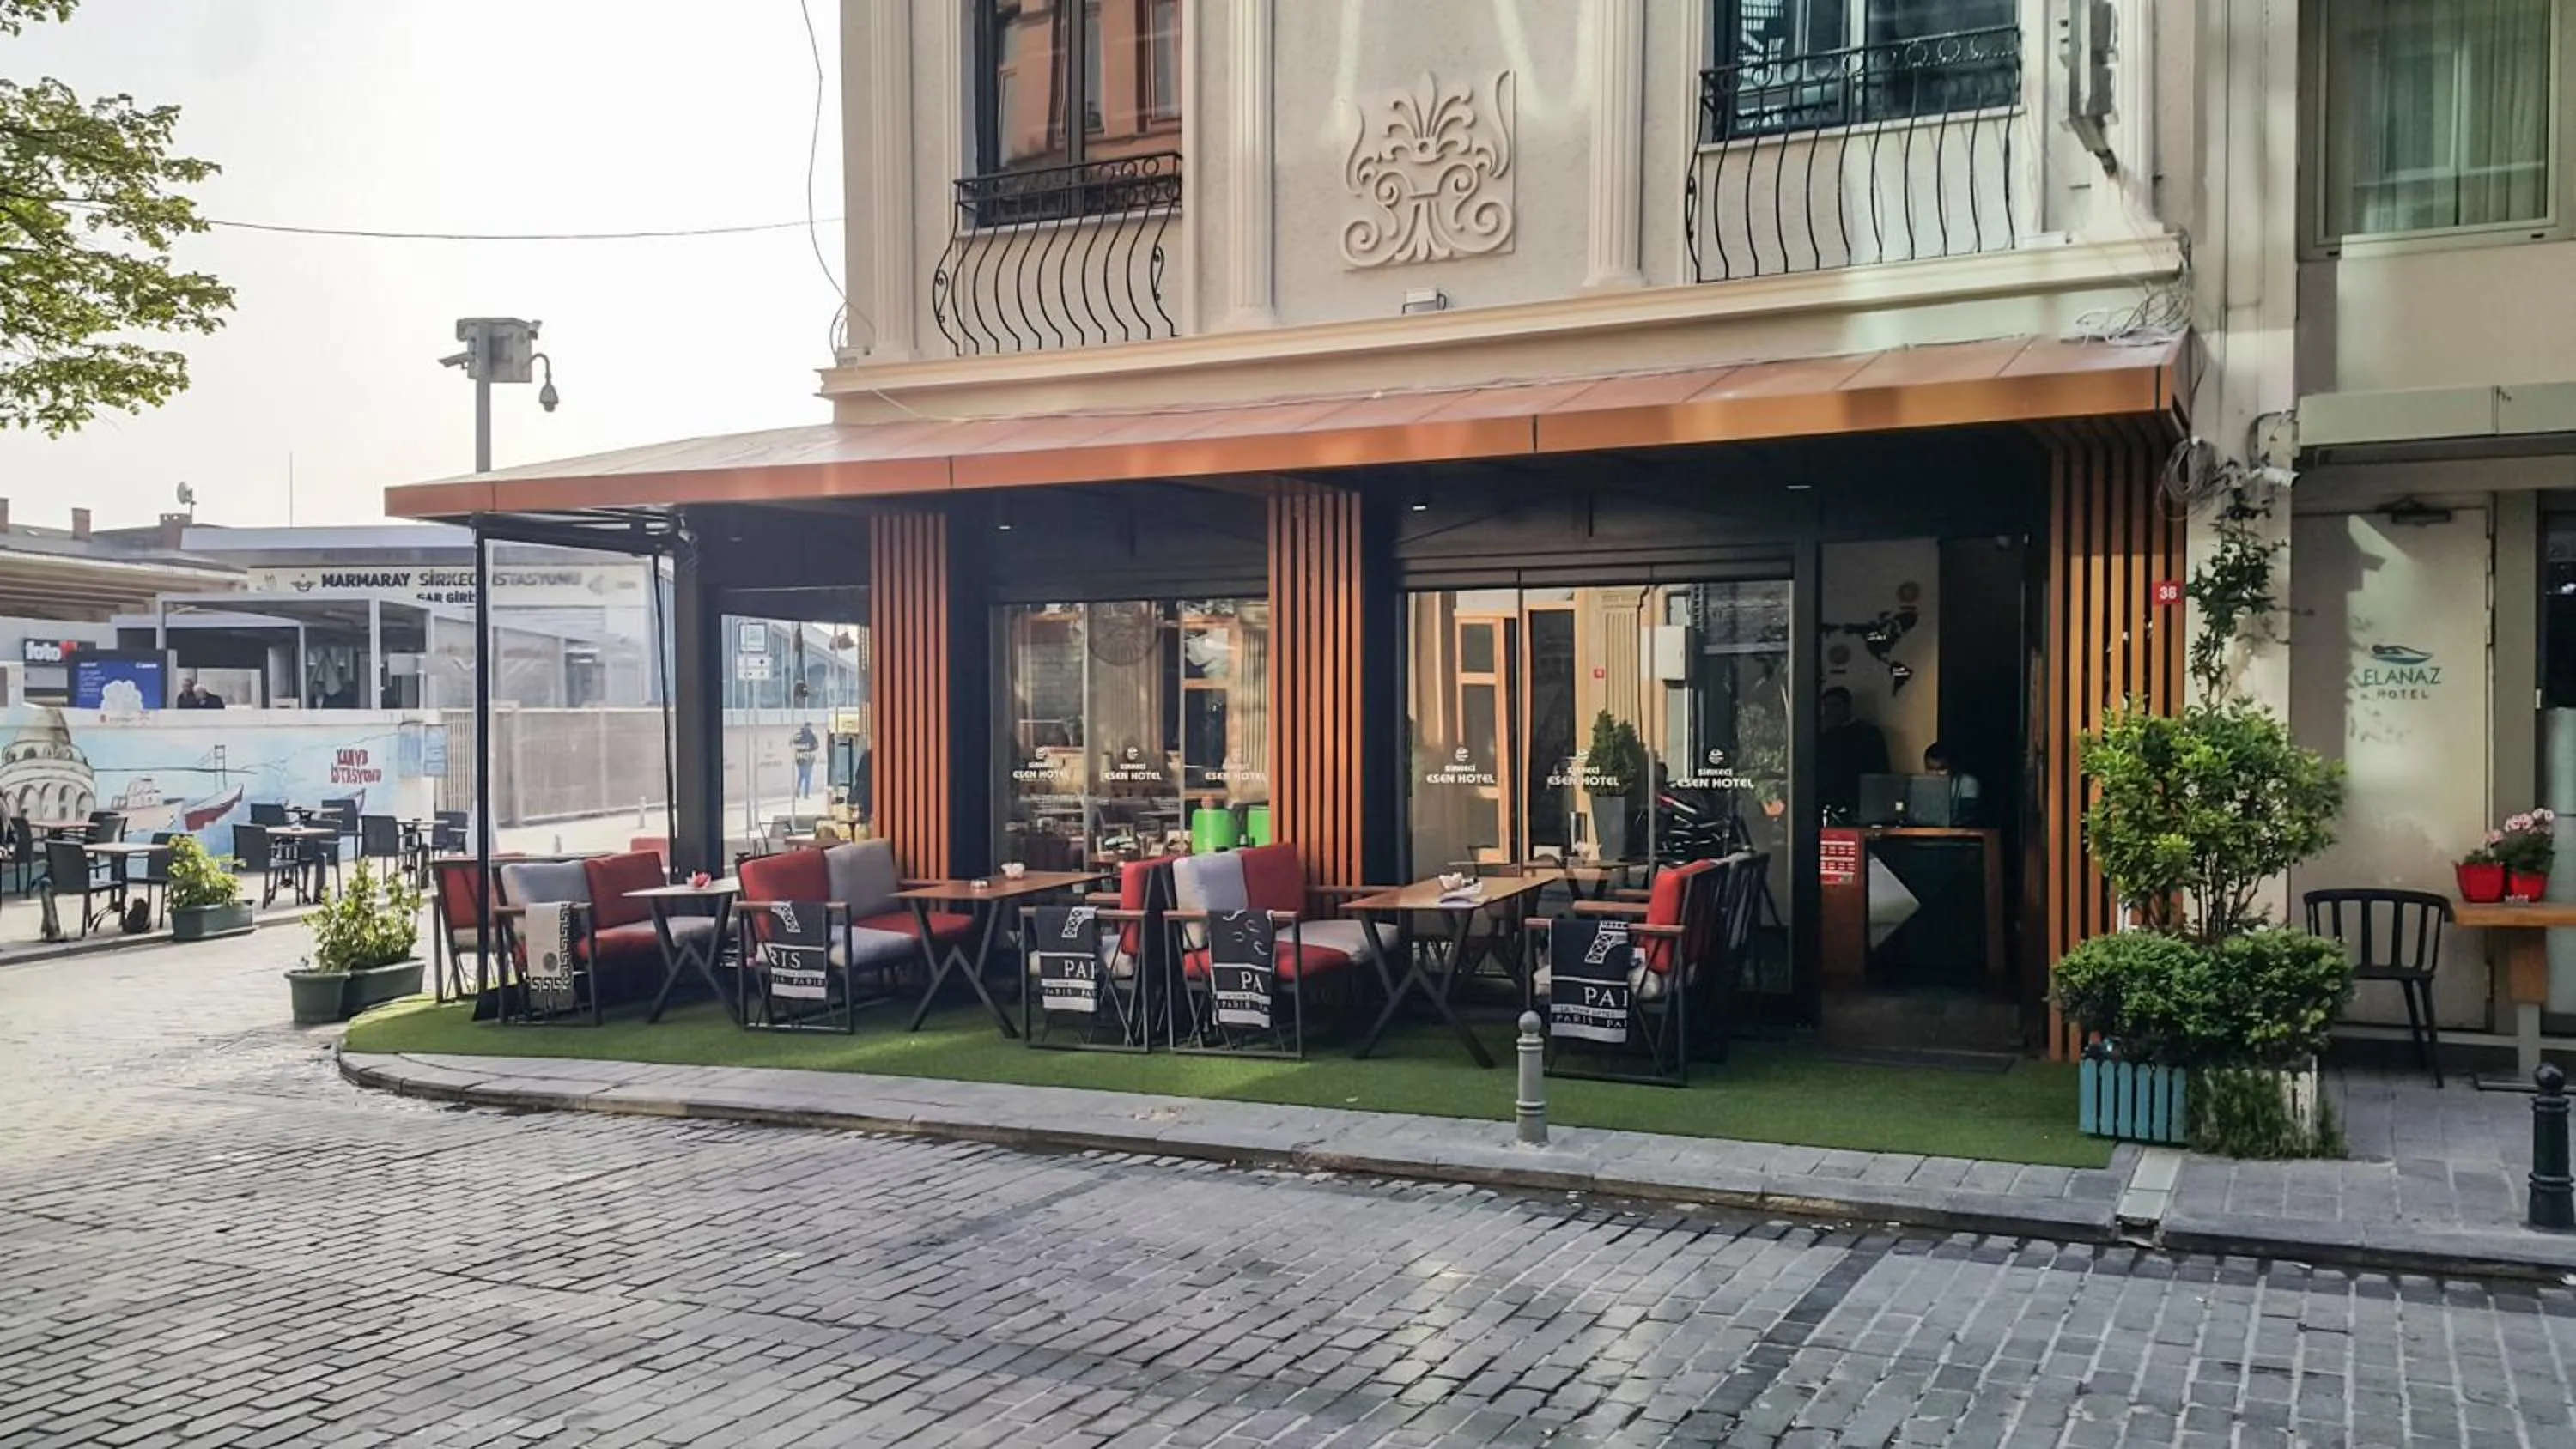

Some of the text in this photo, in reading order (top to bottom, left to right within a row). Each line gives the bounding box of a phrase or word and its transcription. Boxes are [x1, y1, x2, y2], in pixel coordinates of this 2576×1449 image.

[321, 573, 410, 587] MARMARAY
[418, 570, 477, 586] SİRKEC
[2364, 667, 2442, 686] ELANAZ
[2377, 689, 2429, 700] HOTEL
[1131, 771, 1163, 780] HOTEL
[1426, 773, 1495, 784] ESEN HOTEL
[1581, 775, 1619, 786] HOTEL
[1711, 777, 1754, 789] HOTEL
